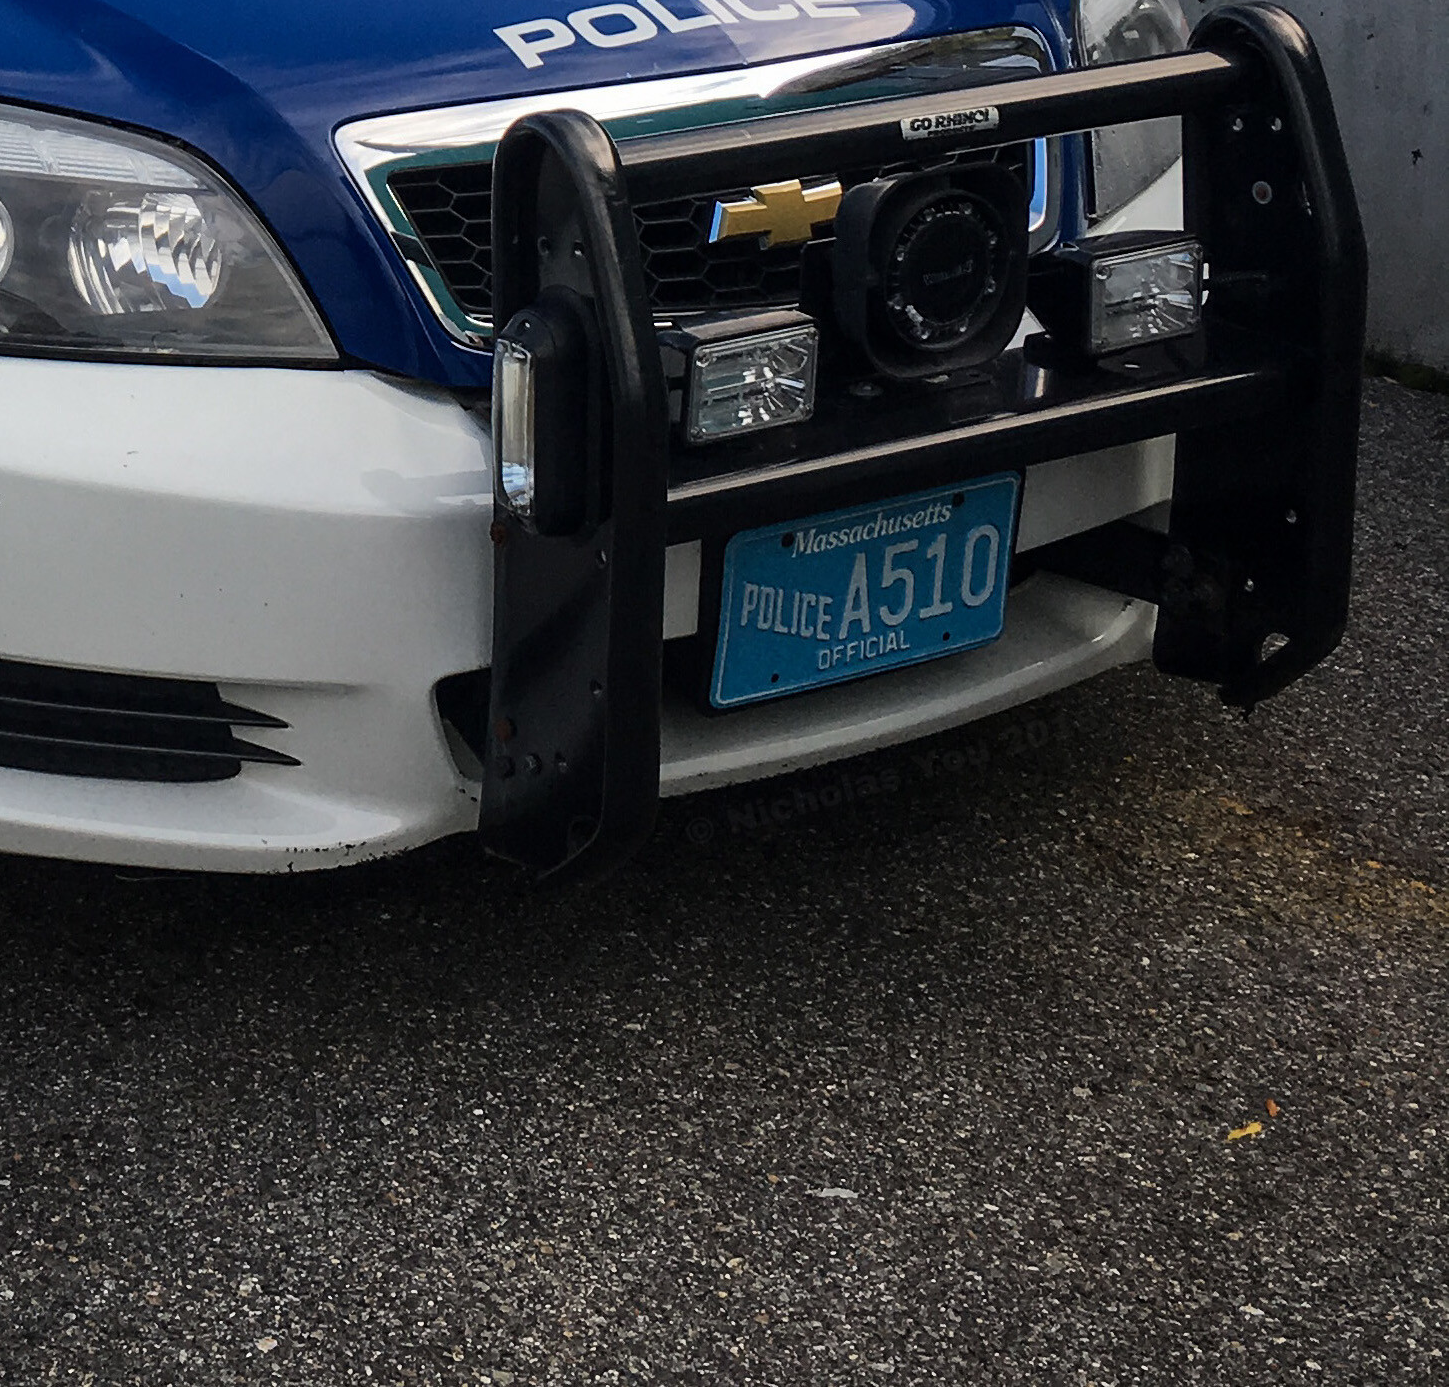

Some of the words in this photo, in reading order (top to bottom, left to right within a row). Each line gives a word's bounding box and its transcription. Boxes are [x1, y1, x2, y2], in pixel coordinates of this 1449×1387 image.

[909, 117, 933, 132] GO
[791, 501, 952, 558] Massachusetts
[740, 581, 834, 641] POLICE
[838, 524, 1000, 640] A510
[817, 630, 911, 670] OFFICIAL
